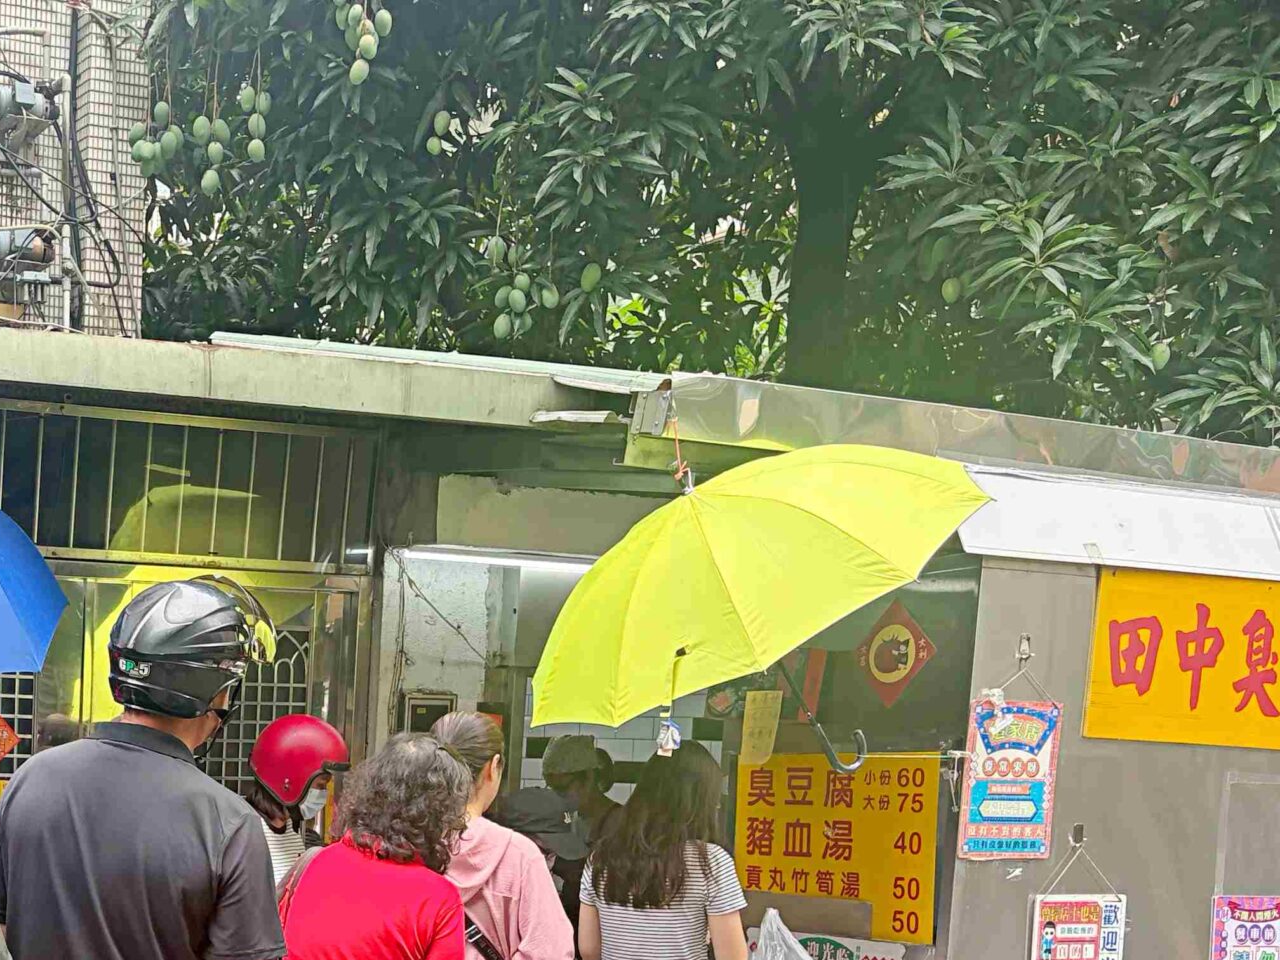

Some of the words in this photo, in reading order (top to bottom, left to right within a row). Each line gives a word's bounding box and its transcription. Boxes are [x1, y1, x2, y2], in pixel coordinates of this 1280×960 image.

[1108, 602, 1280, 718] 田中臭
[747, 767, 855, 809] 臭豆腐
[864, 769, 892, 786] 小份
[897, 767, 925, 788] 60
[863, 795, 890, 811] 大份
[897, 793, 924, 813] 75
[746, 817, 854, 861] 豬血湯
[894, 831, 922, 855] 40
[745, 865, 860, 898] 貢丸竹筍湯
[893, 876, 920, 901] 50
[892, 910, 919, 935] 50
